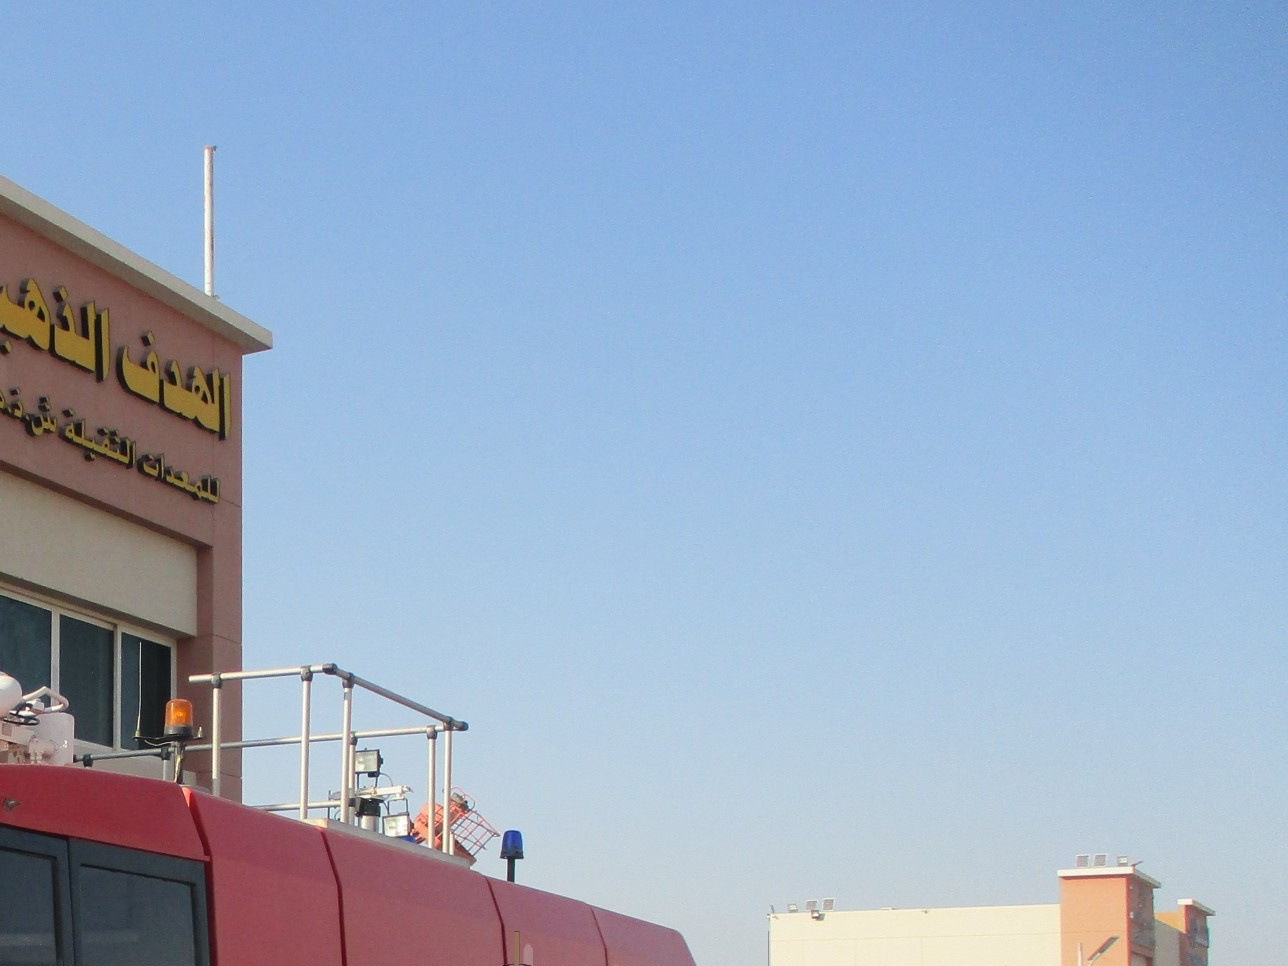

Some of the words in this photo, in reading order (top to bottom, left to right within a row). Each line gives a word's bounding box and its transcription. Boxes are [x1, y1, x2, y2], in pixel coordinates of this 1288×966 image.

[117, 331, 231, 440] الهدف
[59, 408, 136, 469] الثقيلة
[137, 453, 220, 504] للمعدات
